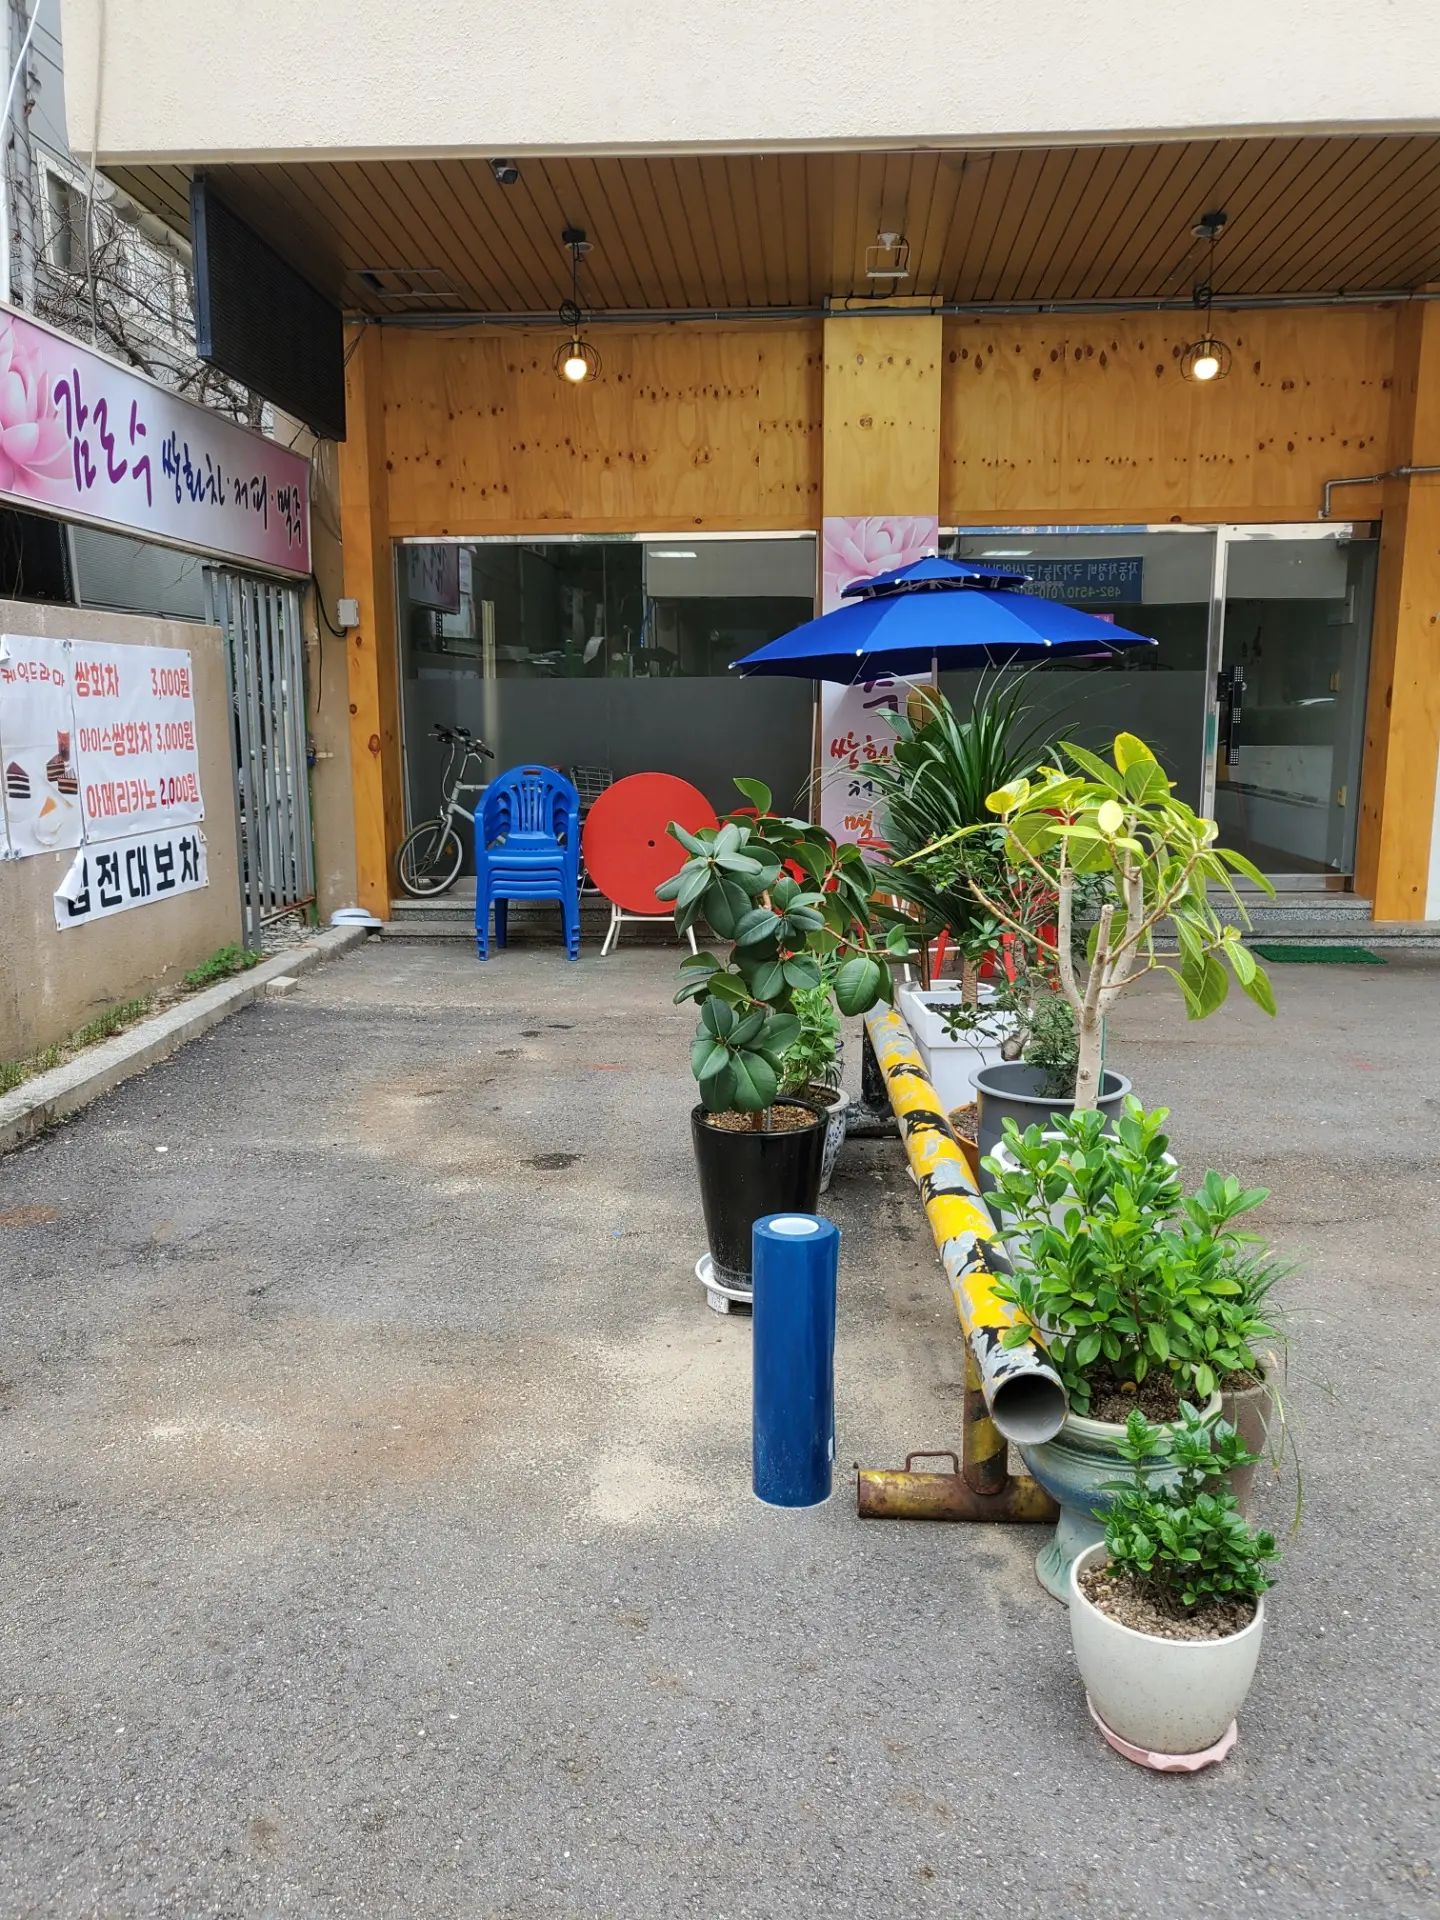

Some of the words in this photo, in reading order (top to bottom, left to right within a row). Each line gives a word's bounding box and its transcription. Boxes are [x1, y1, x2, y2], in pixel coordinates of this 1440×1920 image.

[75, 661, 119, 697] 쌍화차
[80, 721, 152, 756] 아이스쌍화차
[86, 777, 157, 818] 아메리카노
